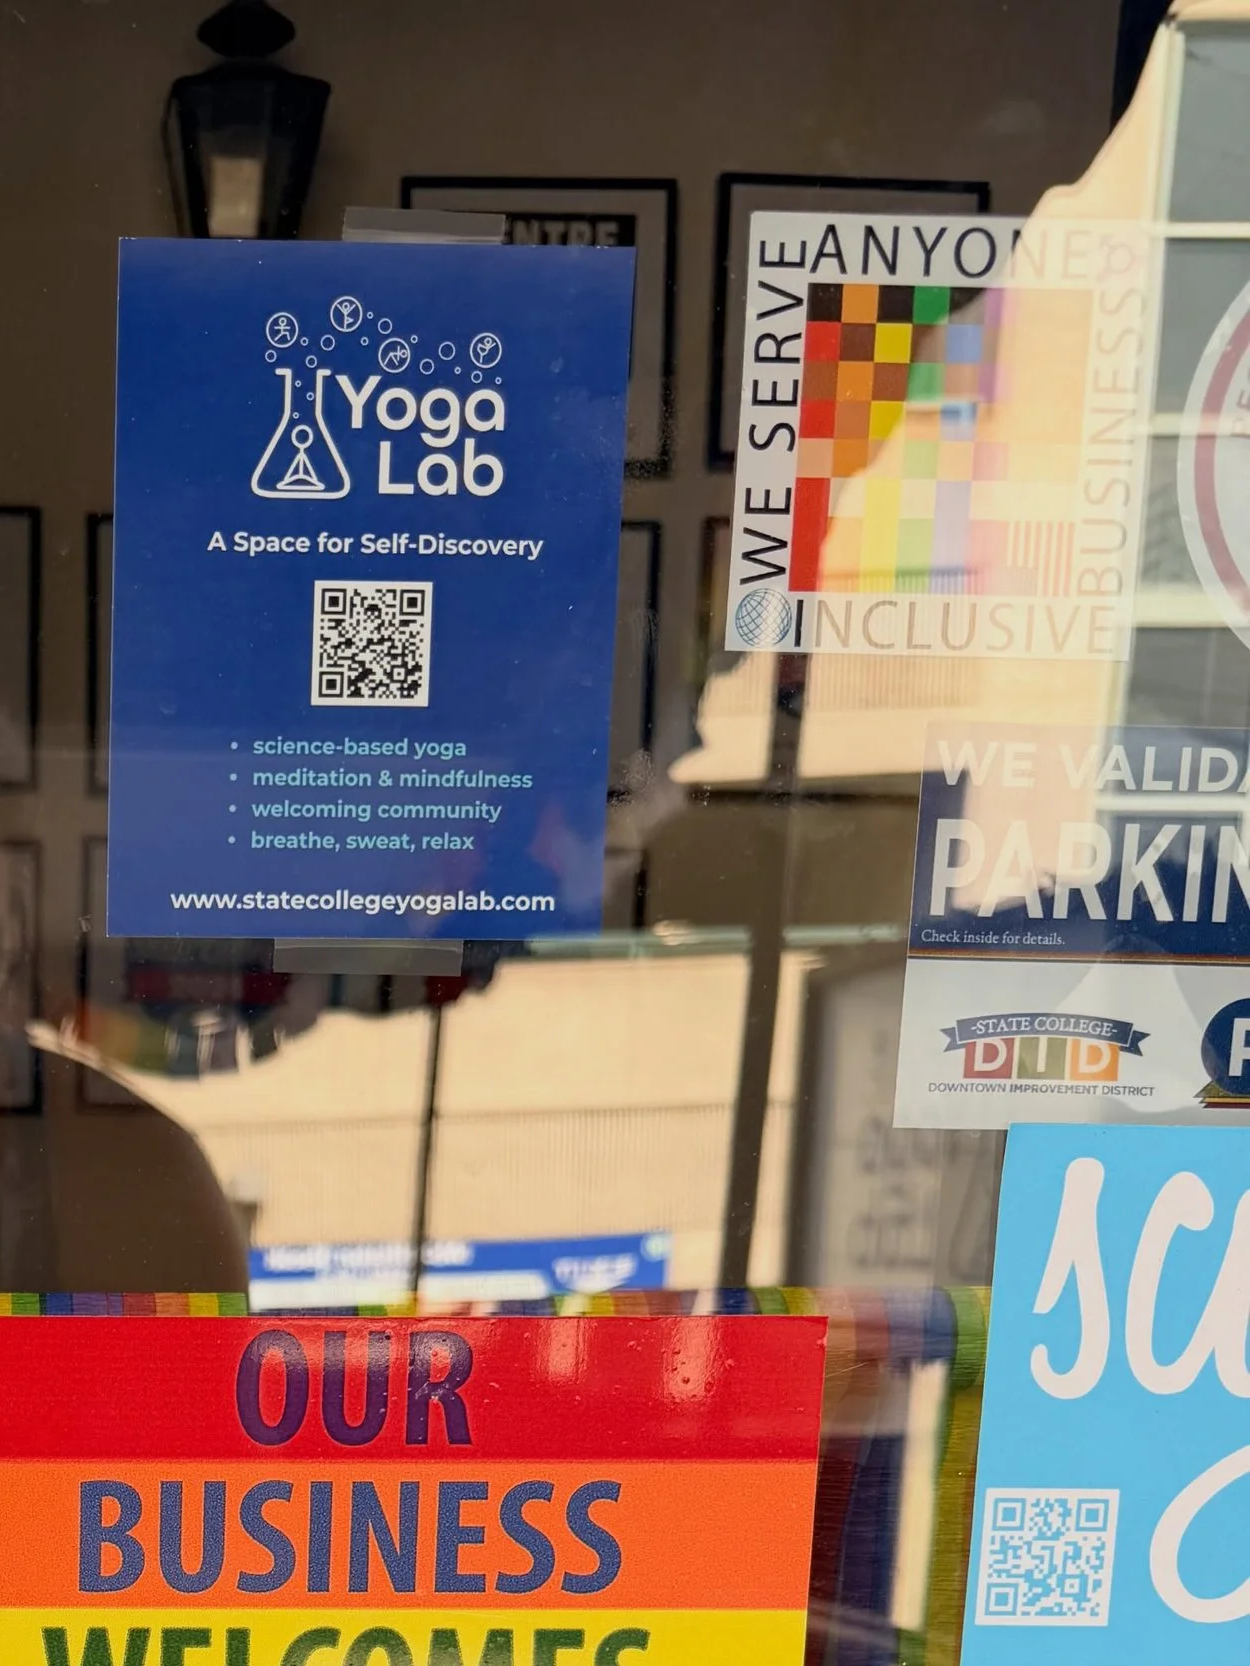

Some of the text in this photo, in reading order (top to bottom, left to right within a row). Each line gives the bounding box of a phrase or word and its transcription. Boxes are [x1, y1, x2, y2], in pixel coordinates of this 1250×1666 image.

[809, 223, 1093, 281] ANYONE
[336, 375, 506, 447] Yoga
[739, 239, 805, 584] WE SERVE
[378, 439, 504, 496] Lab
[1079, 288, 1147, 597] BUSINESS
[207, 532, 543, 560] A Space for Self-Discovery
[794, 598, 1117, 654] INCLUSIVE
[253, 736, 466, 761] science-based yoga
[938, 740, 1250, 793] WE VALID
[253, 768, 533, 789] meditation & mindfulness
[252, 799, 502, 823] welcoming community
[252, 831, 474, 852] breathe, sweat, relax
[170, 889, 556, 914] www.statecollegeyogalab.com
[921, 930, 1065, 946] Check inside for details.
[928, 1082, 1154, 1097] DOWNTOWN IMPROVEMENT DISTRICT
[235, 1329, 474, 1446] OUR
[78, 1480, 623, 1594] BUSINESS
